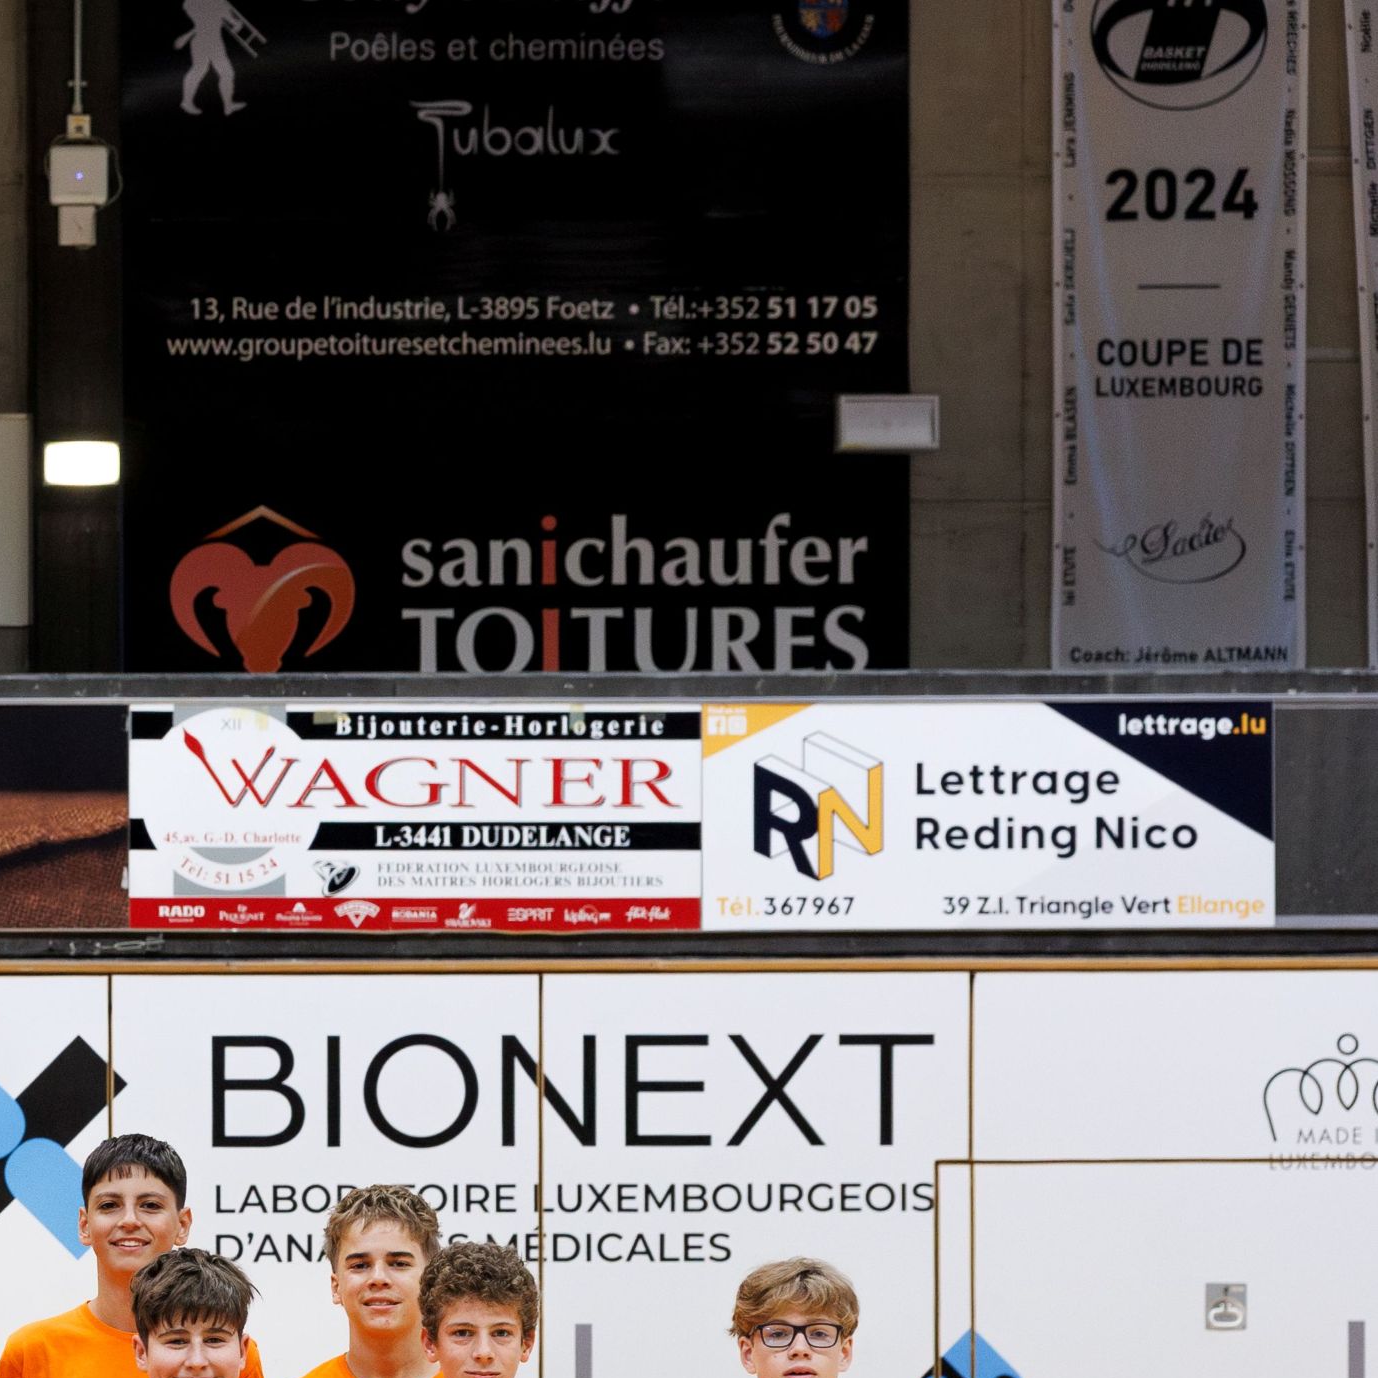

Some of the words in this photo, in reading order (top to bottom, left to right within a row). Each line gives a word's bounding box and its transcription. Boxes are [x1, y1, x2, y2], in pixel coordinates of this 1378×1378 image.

[330, 32, 437, 62] Poêles
[447, 38, 479, 62] et
[489, 31, 665, 62] cheminées
[1105, 167, 1259, 221] 2024
[190, 297, 226, 325] 13,
[232, 298, 280, 321] Rue
[285, 296, 317, 321] de
[457, 297, 540, 321] L-3895
[546, 296, 615, 321] Foetz
[768, 297, 801, 321] 51
[807, 297, 839, 321] 17
[844, 297, 878, 321] 05
[167, 331, 612, 362] www.groupetoituresetcheminees.lu
[644, 332, 692, 356] Fax:
[697, 332, 760, 356] +352
[767, 332, 800, 356] 52
[806, 332, 839, 356] 50
[845, 332, 878, 356] 47
[1097, 338, 1208, 368] COUPE
[1223, 338, 1264, 367] DE
[1095, 376, 1263, 398] LUXEMBOURG
[400, 513, 869, 588] sanichaufer
[401, 605, 870, 671] TOITURES
[1069, 647, 1131, 664] Coach:
[1203, 646, 1289, 664] ALTMANN
[336, 715, 665, 740] Bijouterie-Horlogerie
[1118, 713, 1267, 740] lettrage.lu
[182, 727, 683, 808] WAGNER
[916, 762, 1120, 803] Lettrage
[242, 831, 302, 845] Charlotte
[374, 825, 453, 848] L-3441
[461, 825, 631, 848] DUDELANGE
[916, 817, 1078, 858] Reding
[1095, 817, 1199, 849] Nico
[236, 868, 256, 884] 15
[377, 876, 406, 887] DES
[483, 876, 572, 887] HORLOGERS
[475, 862, 623, 874] LUXEMBOURGEOISE
[158, 905, 205, 918] RADO
[717, 896, 760, 916] Tél.
[764, 897, 855, 915] 367967
[943, 897, 970, 915] 39
[1016, 896, 1114, 920] Triangle
[1121, 897, 1172, 915] Vert
[1178, 896, 1265, 920] Ellange
[211, 1033, 935, 1150] BIONEXT
[1296, 1126, 1362, 1145] MADE
[532, 1182, 935, 1214] LUXEMBOURGEOIS
